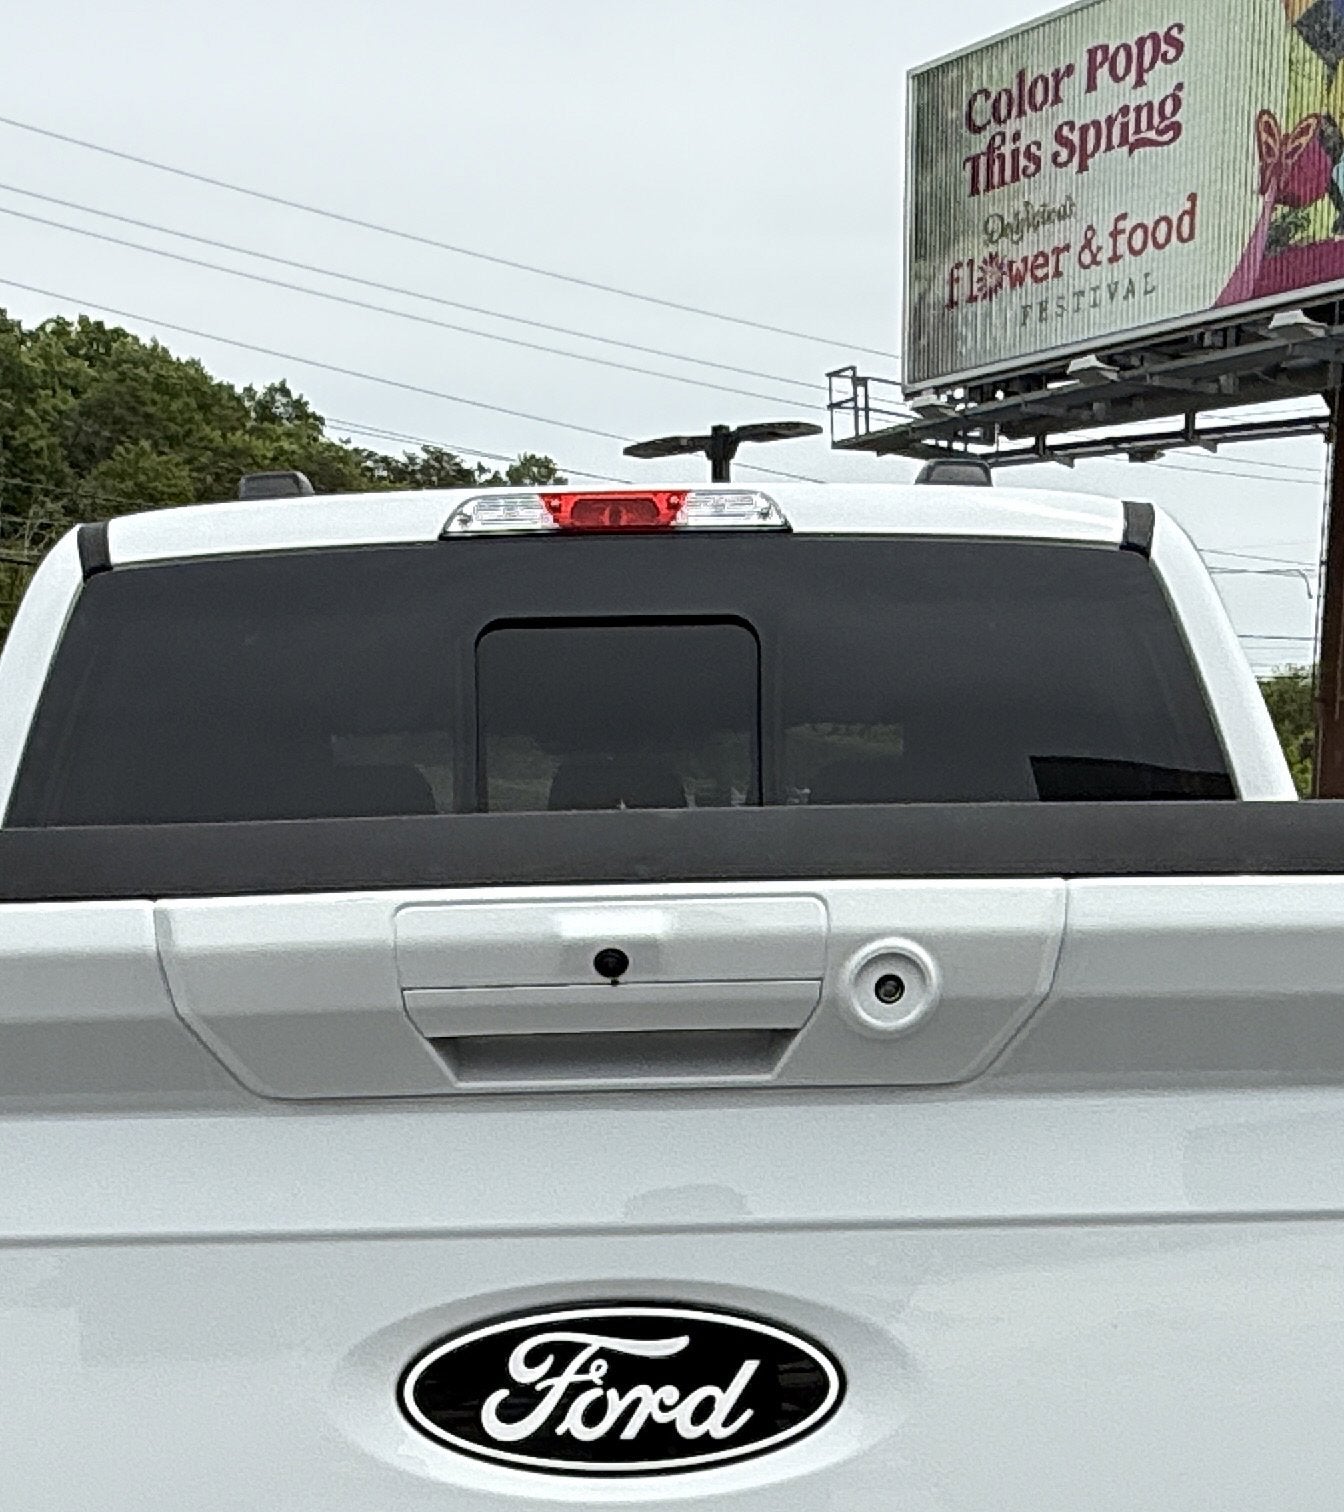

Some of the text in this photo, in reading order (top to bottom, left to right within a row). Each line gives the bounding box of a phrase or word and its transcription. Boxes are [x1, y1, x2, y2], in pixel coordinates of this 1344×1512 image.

[965, 22, 1184, 134] Color Pops
[963, 82, 1184, 197] This Spring
[1107, 192, 1198, 265] food
[1020, 272, 1156, 326] FESTIVAL
[480, 1331, 760, 1442] Ford
